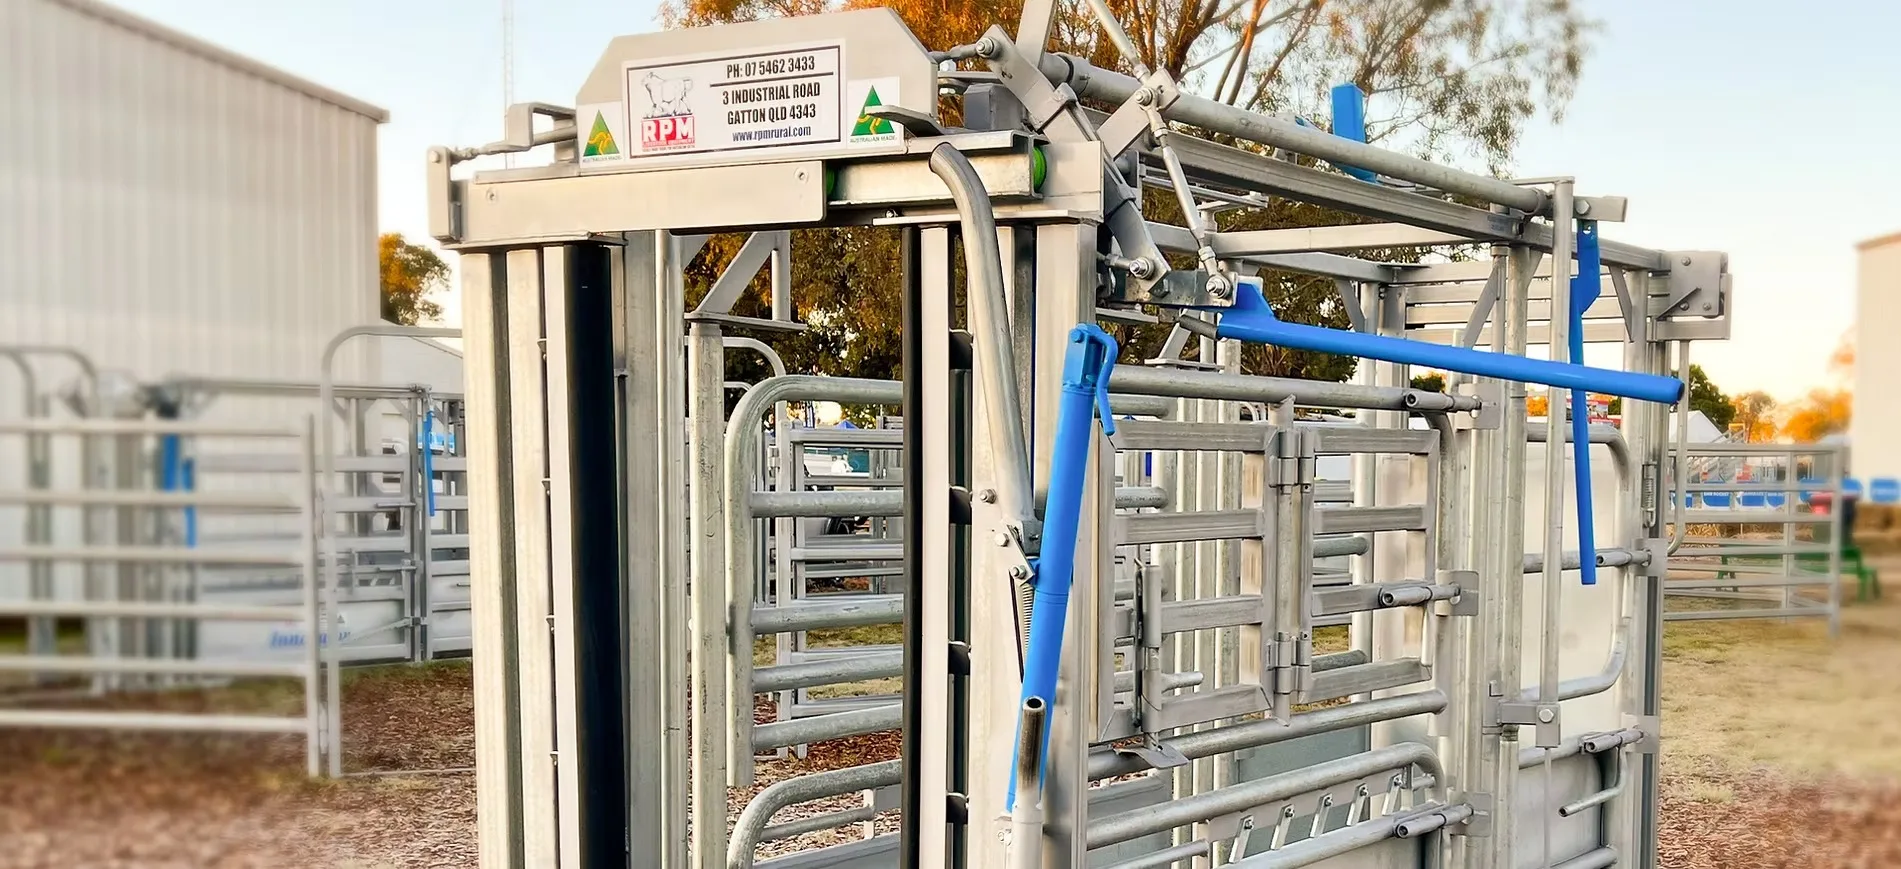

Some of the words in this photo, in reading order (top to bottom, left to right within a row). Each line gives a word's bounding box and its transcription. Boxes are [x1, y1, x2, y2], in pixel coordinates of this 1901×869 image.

[727, 64, 743, 79] PH:
[744, 62, 757, 76] 07
[759, 58, 786, 75] 5462
[788, 55, 815, 72] 3433
[722, 91, 729, 105] 3
[731, 86, 790, 104] INDUSTRIAL
[793, 82, 820, 98] ROAD
[727, 107, 766, 125] GATTON
[768, 106, 787, 123] QLD
[789, 103, 816, 119] 4343
[643, 117, 694, 142] RPM
[732, 125, 811, 142] www.rpmrural.com
